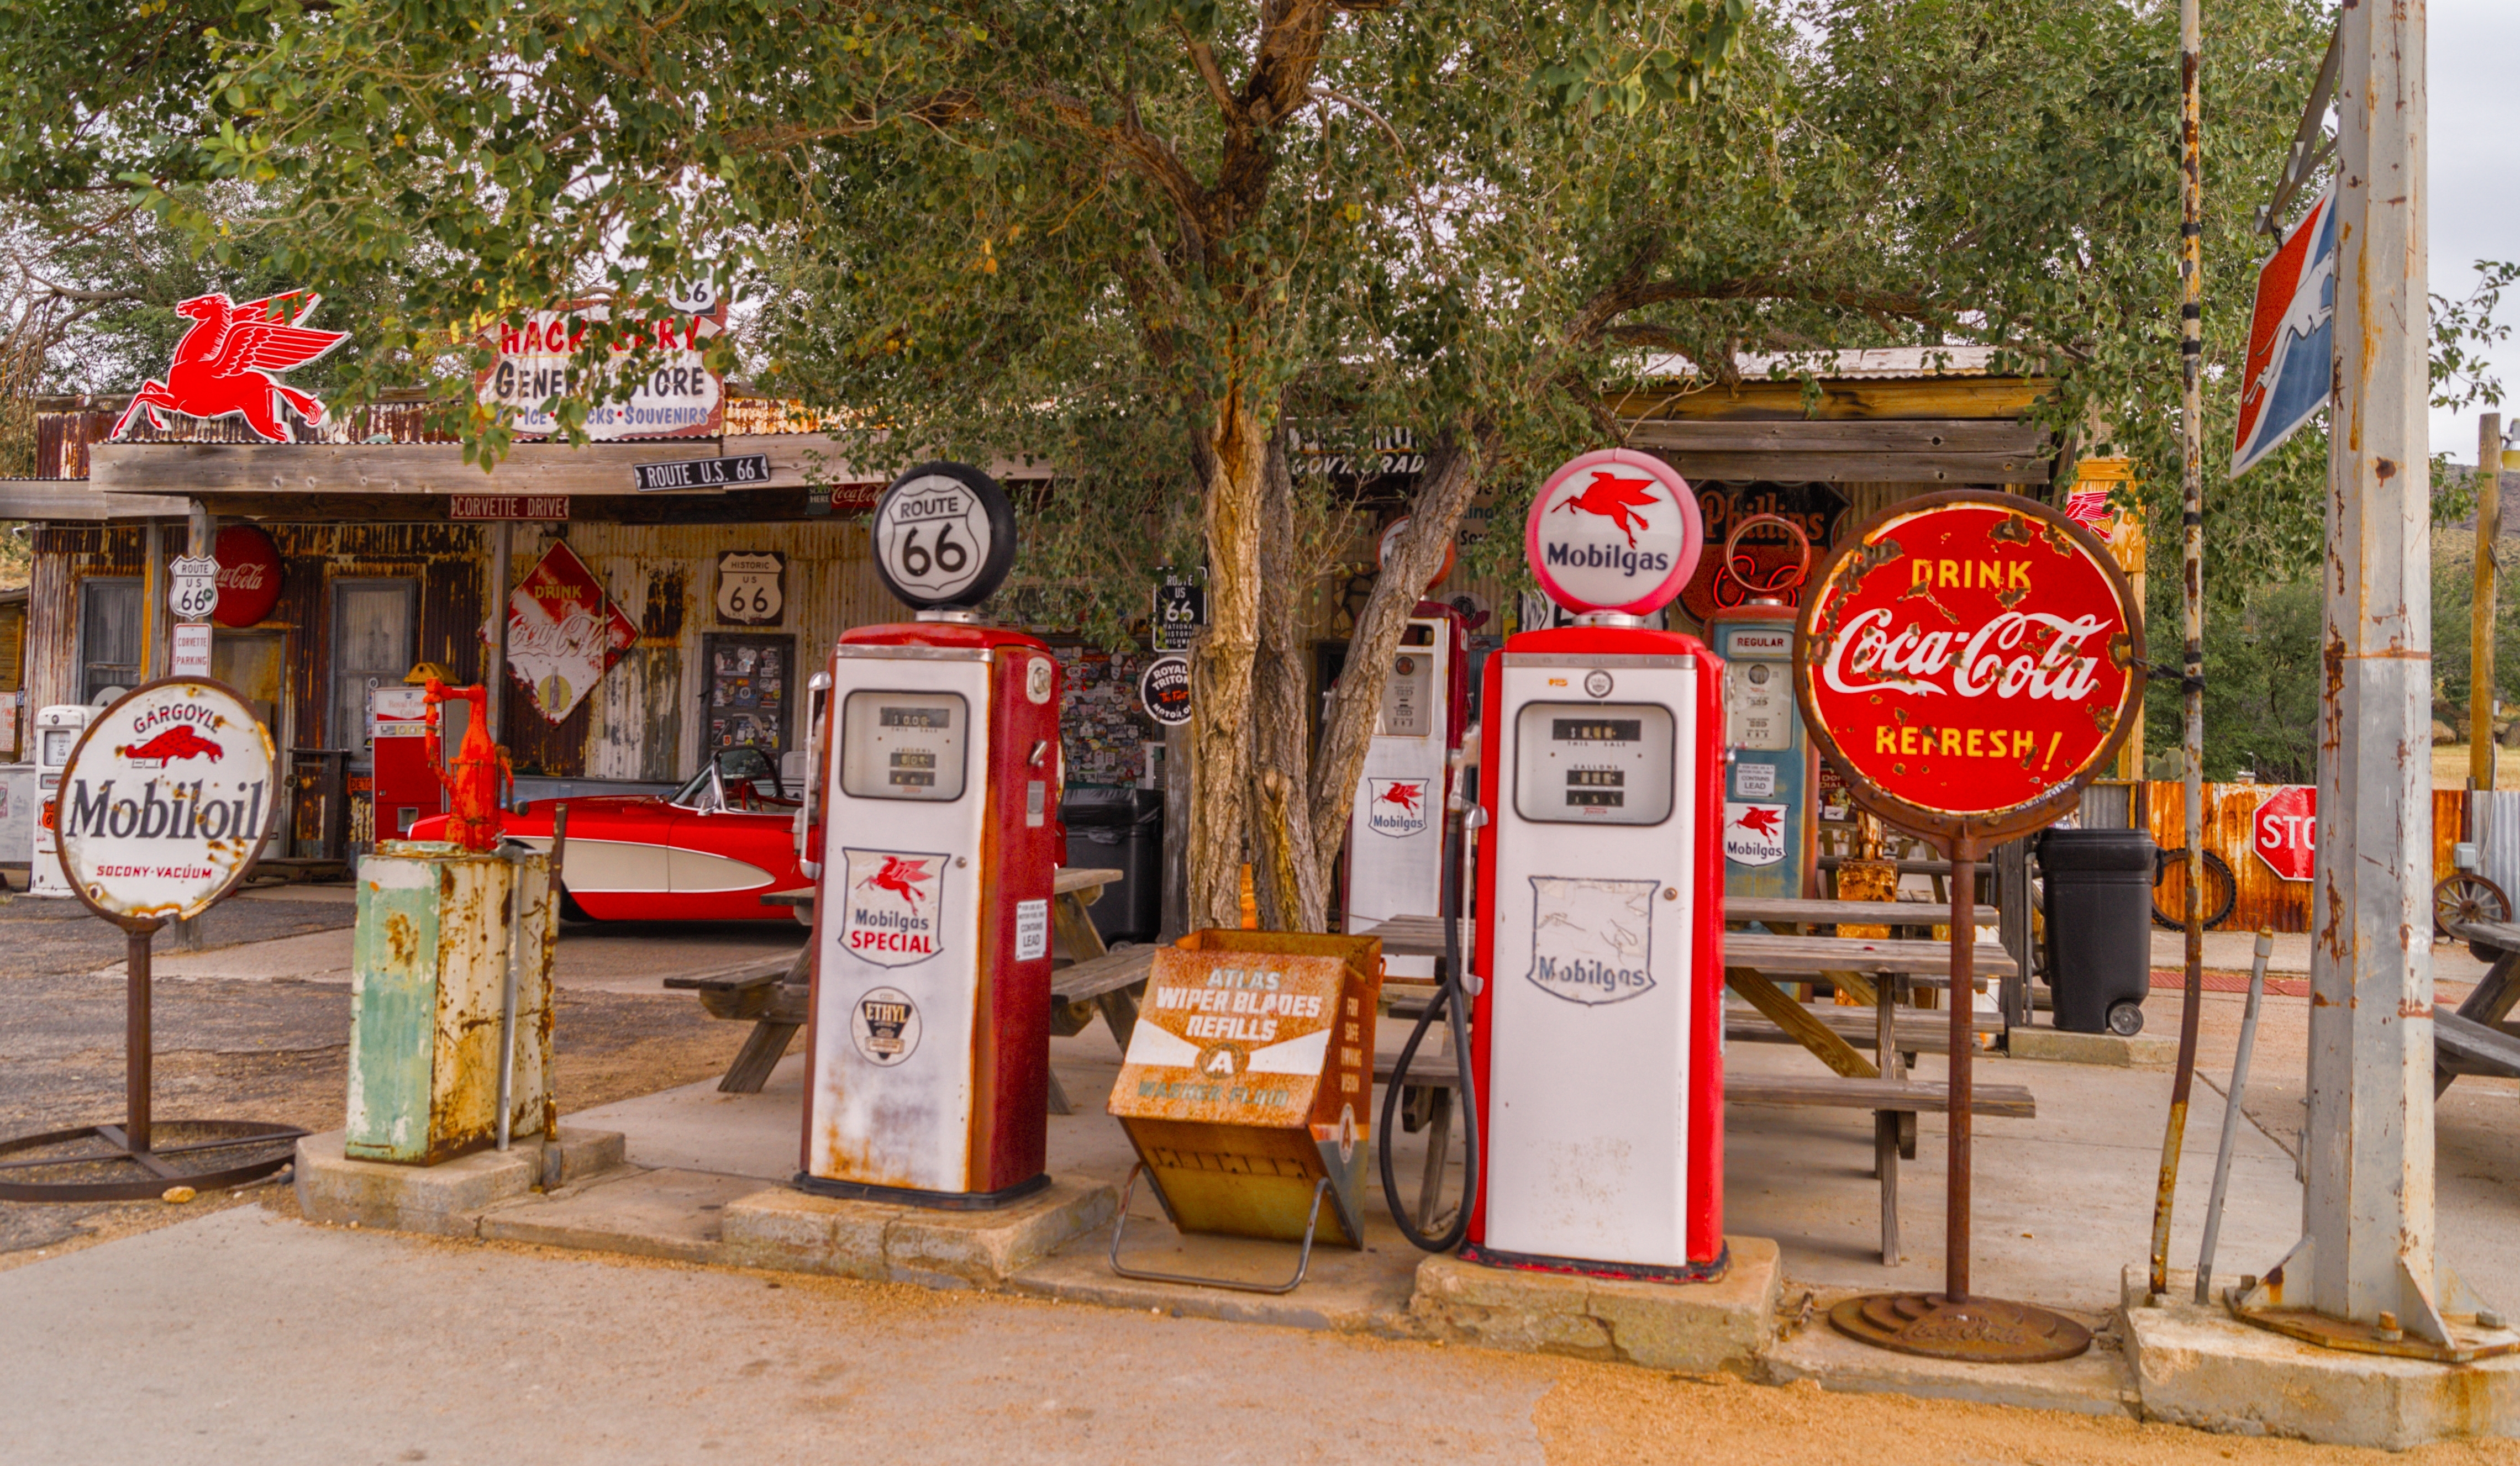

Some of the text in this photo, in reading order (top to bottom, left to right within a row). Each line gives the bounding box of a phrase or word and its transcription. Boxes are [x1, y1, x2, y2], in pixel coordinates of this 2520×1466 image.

[501, 315, 701, 354] HACKRY
[524, 405, 546, 425] ICE
[624, 405, 708, 425] SOUVENIRS
[646, 458, 755, 488] ROUTE U.S. 66
[456, 497, 564, 518] CORVETTE DRIVE
[900, 497, 959, 519] ROUTE
[1700, 490, 1825, 552] Phillips
[902, 522, 967, 577] 66
[1548, 542, 1669, 577] Mobilgas
[182, 564, 209, 574] ROUTE
[217, 563, 267, 590] ca-Cola
[1912, 558, 2033, 590] DRINK
[181, 590, 206, 610] 66
[534, 585, 582, 599] DRINK
[730, 586, 768, 613] 66
[1175, 587, 1186, 599] US
[1166, 600, 1194, 623] 66
[178, 637, 207, 647] CORVETTE
[1737, 637, 1784, 647] REGULAR
[176, 656, 207, 666] PARKING
[1824, 608, 2113, 702] Coca-Cola
[1153, 665, 1187, 679] ROYAL
[134, 703, 222, 735] GARGOYLE
[1153, 703, 1182, 719] MOTOR
[1744, 782, 1766, 790] LEAD
[65, 778, 265, 840] Mobiloil
[1374, 815, 1423, 831] Mobilgas
[2260, 814, 2317, 851] STO
[1727, 841, 1782, 859] Mobilgas
[97, 865, 213, 879] SOCONY-VACUUM
[855, 909, 929, 932] Mobilgas
[851, 930, 933, 954] SPECIAL
[1023, 934, 1041, 947] LEAD
[1206, 968, 1281, 990] ATLAS
[1539, 956, 1645, 992] Mobilgas
[865, 1002, 907, 1024] ETHYL
[1156, 986, 1323, 1018] WIPER BLADES
[1185, 1015, 1279, 1042] REFILLS
[1138, 1080, 1290, 1107] WASHER FLUID
